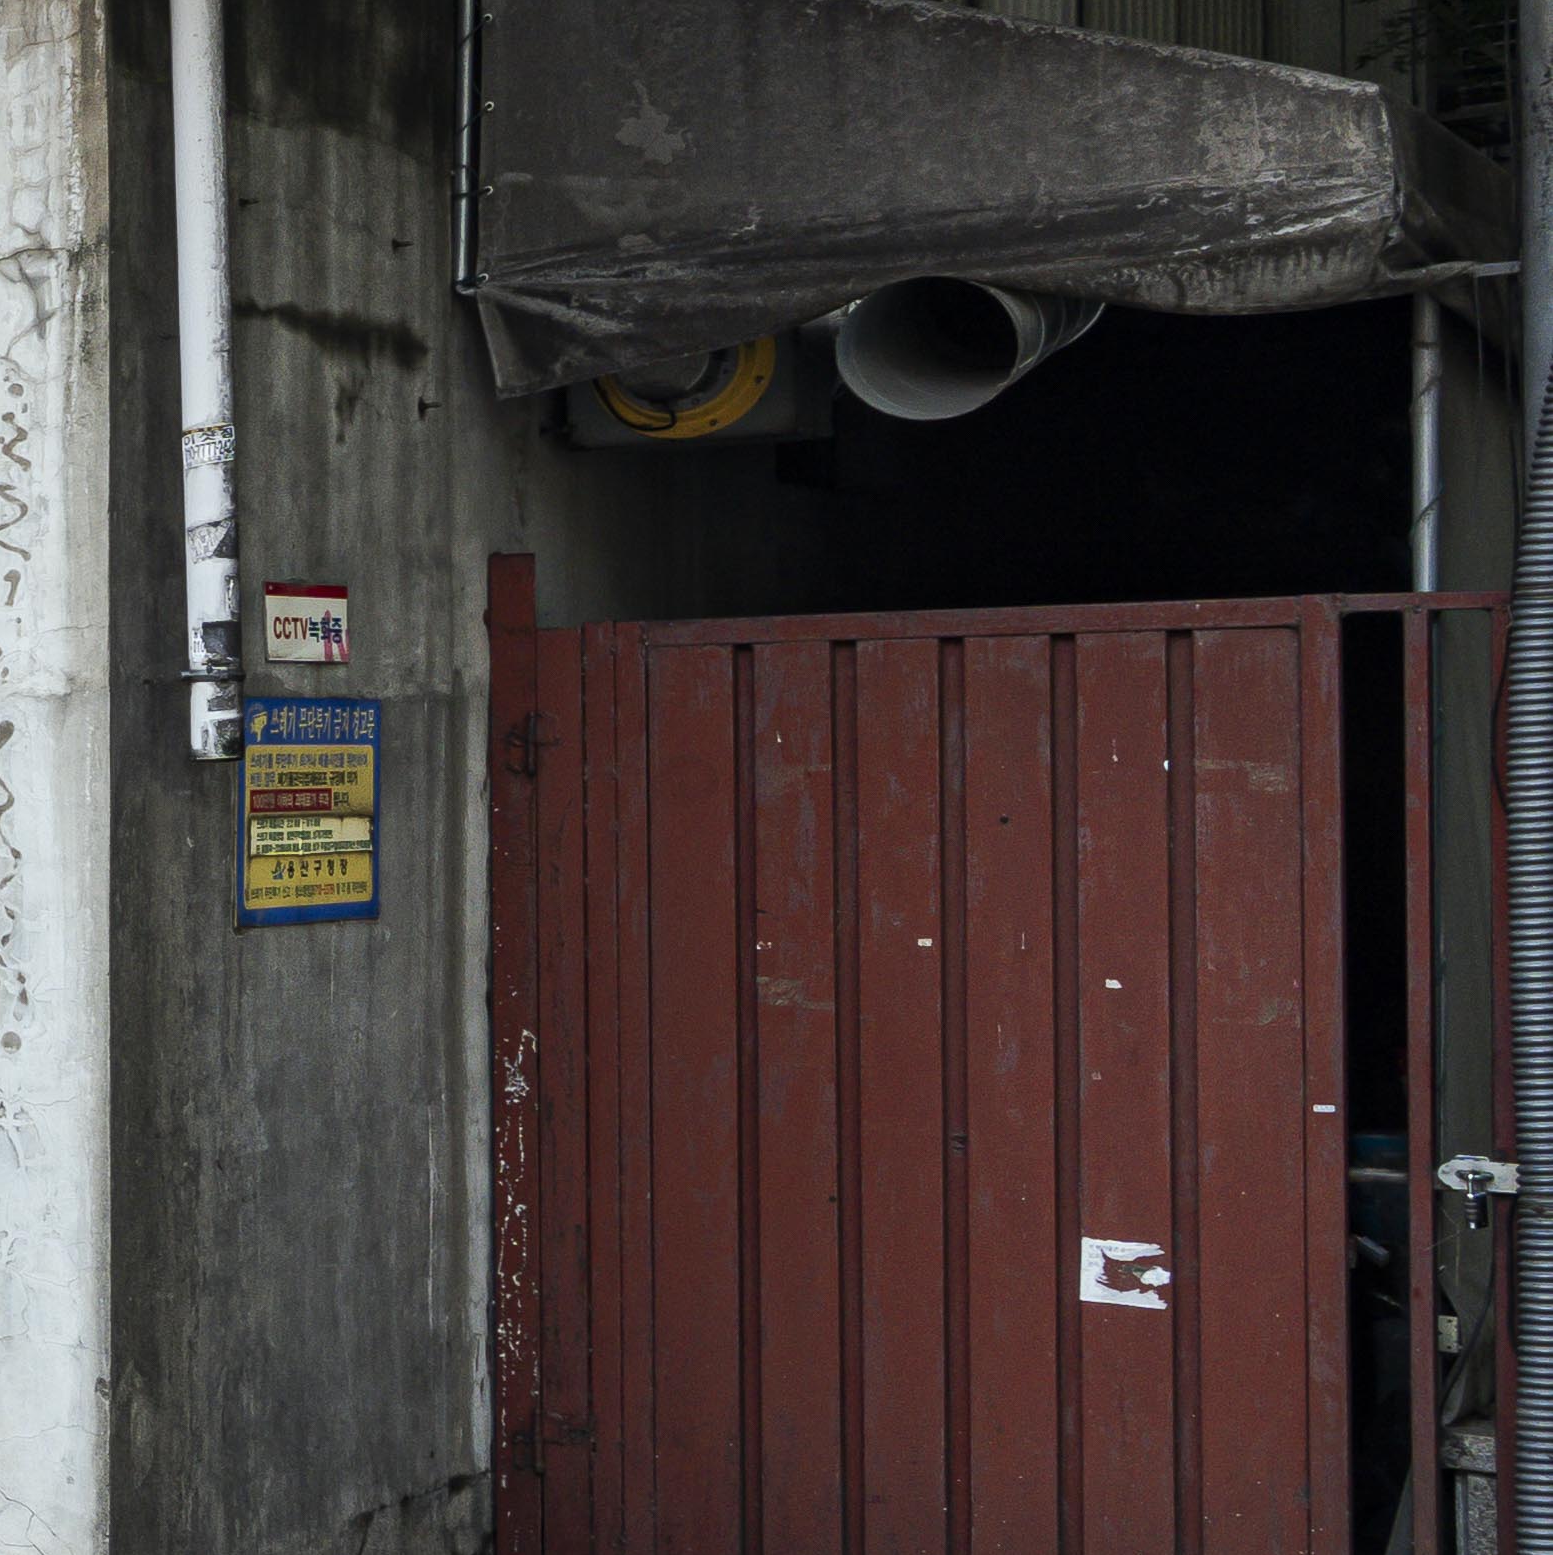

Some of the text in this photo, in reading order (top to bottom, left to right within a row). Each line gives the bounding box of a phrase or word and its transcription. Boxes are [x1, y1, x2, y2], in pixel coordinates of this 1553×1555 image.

[270, 705, 376, 741] 쓰레기 무단투기 금지 경고문
